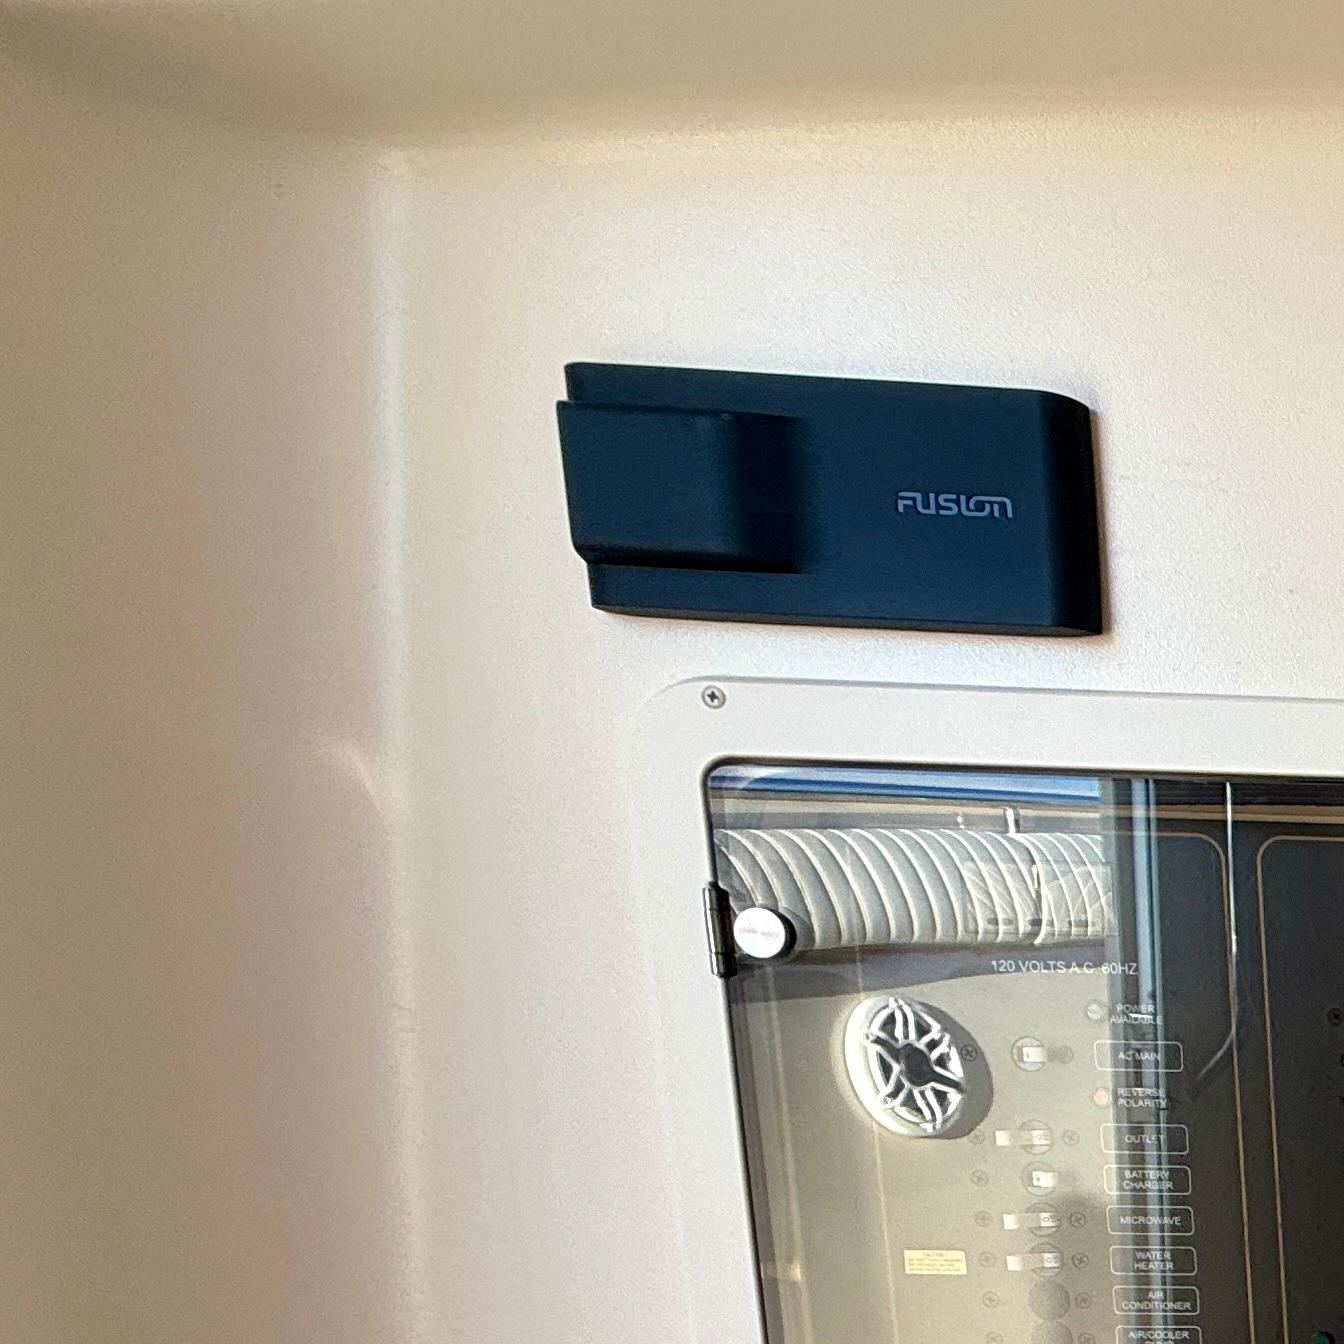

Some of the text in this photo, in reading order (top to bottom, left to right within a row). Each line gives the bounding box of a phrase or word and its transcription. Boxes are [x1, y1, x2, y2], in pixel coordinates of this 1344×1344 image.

[897, 491, 1013, 519] FUSION
[991, 959, 1016, 973] 120
[1018, 960, 1066, 974] VOLTS
[1101, 961, 1137, 975] 60HZ
[1116, 1003, 1156, 1014] POWER
[1110, 1014, 1163, 1025] AVAILABLE
[1118, 1050, 1160, 1061] AC MAIN
[1117, 1087, 1166, 1098] REVERSE
[1117, 1098, 1167, 1108] POLARITY
[1124, 1134, 1164, 1144] OUTLET
[1124, 1169, 1169, 1179] BATTERY
[1123, 1180, 1175, 1190] CHARGER
[1120, 1215, 1181, 1225] MICROWAVE
[1135, 1250, 1171, 1260] WATER
[1134, 1261, 1174, 1271] HEATER
[1147, 1290, 1165, 1300] AIR
[1121, 1301, 1192, 1311] CONDITIONER
[1128, 1330, 1189, 1340] AIR/COOLER
